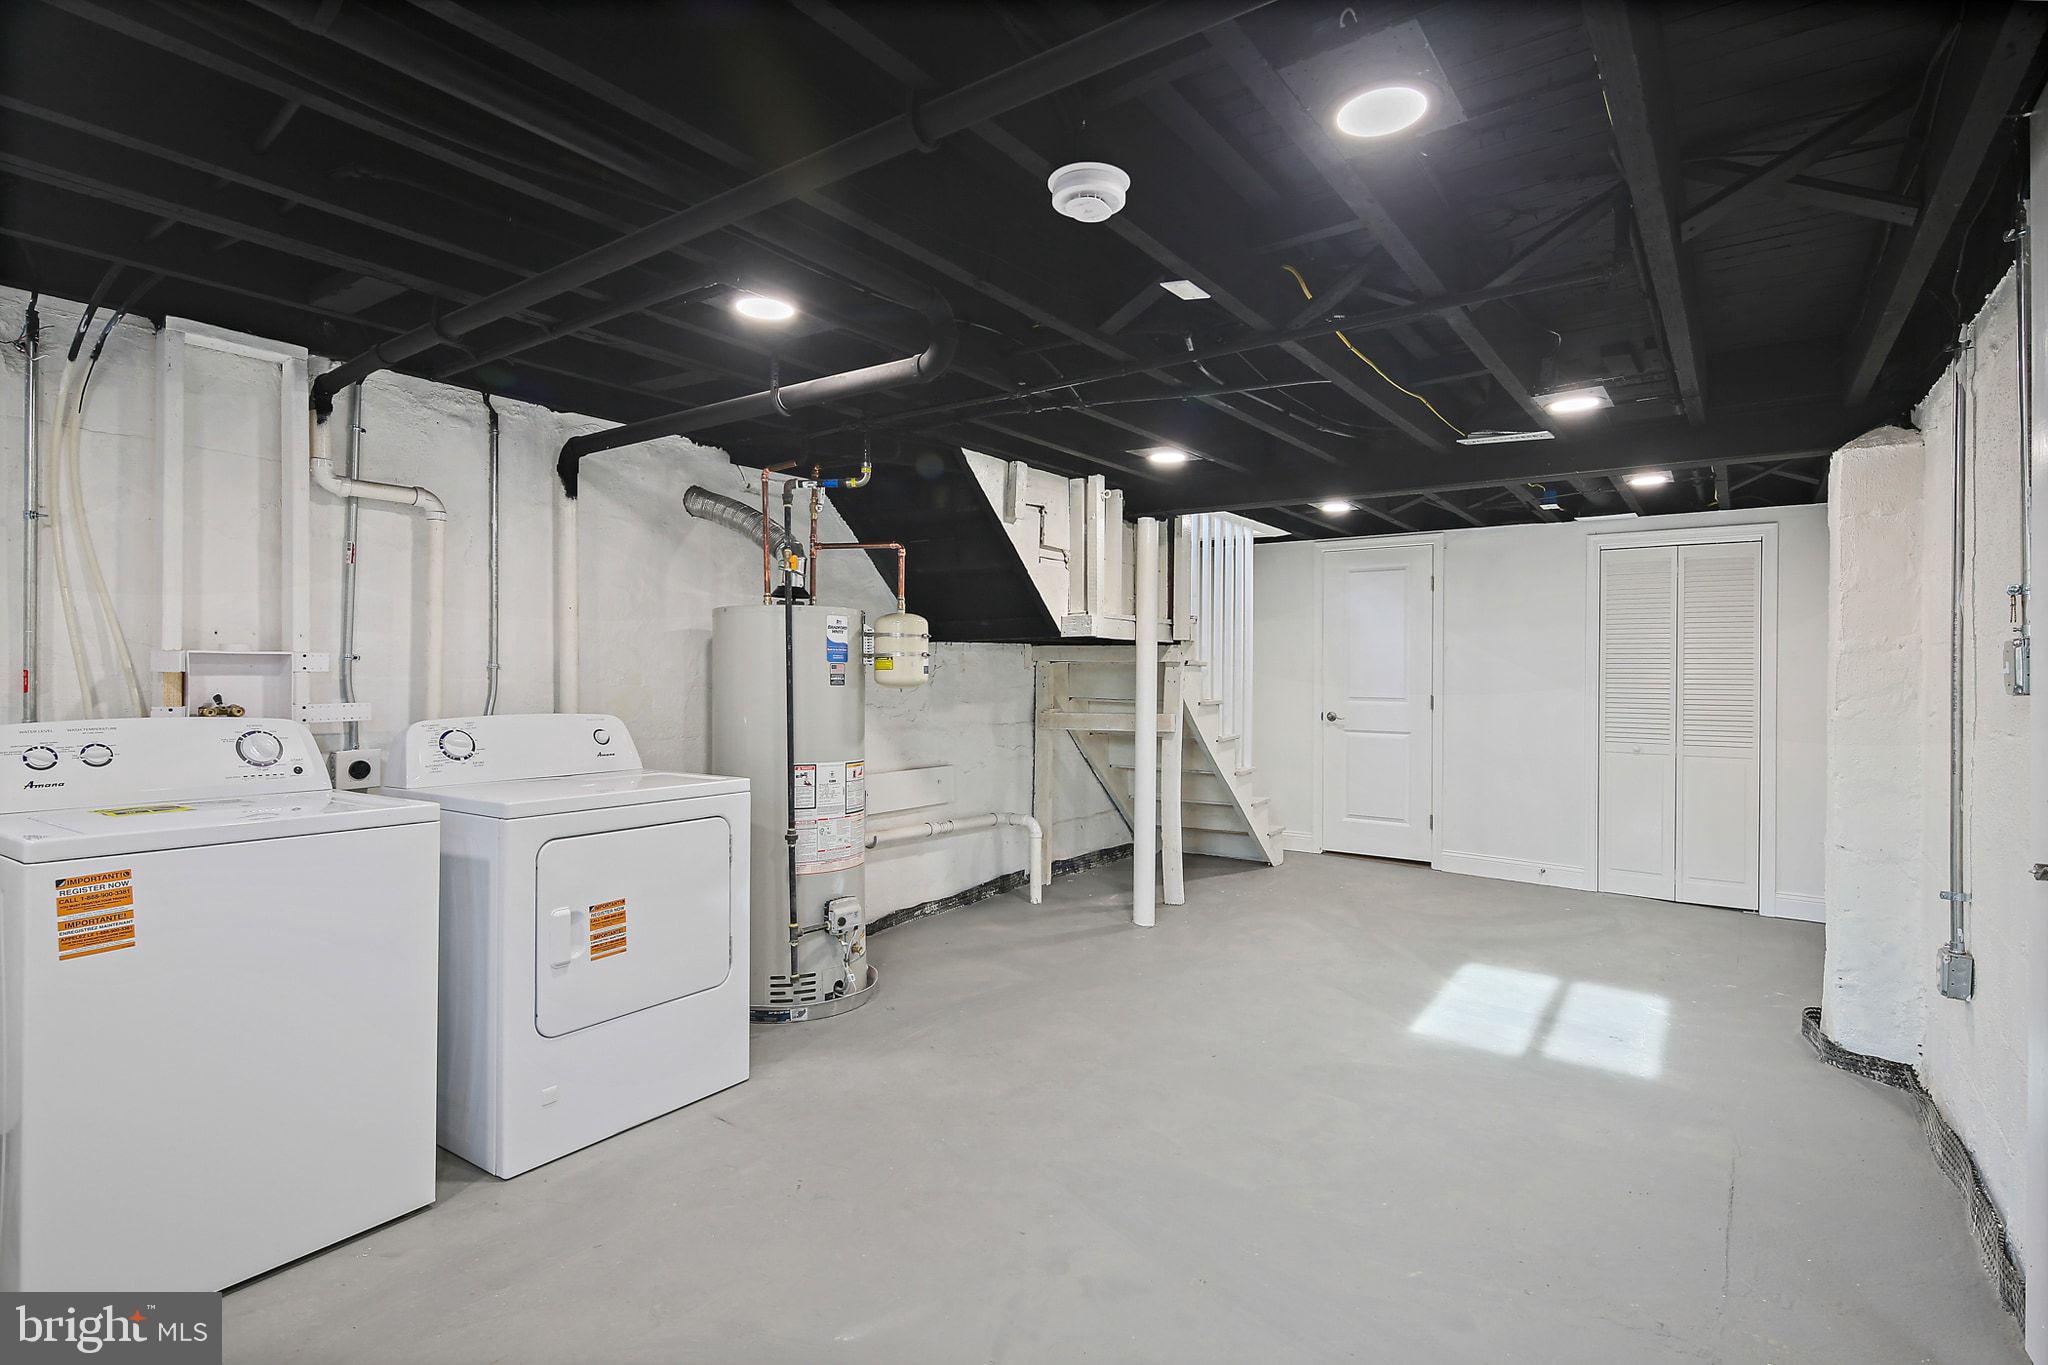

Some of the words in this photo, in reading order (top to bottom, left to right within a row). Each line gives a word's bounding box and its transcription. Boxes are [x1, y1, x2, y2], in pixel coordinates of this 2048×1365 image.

[23, 780, 65, 790] Amana
[66, 871, 122, 886] IMPORTANT!
[59, 884, 106, 896] REGISTER
[108, 880, 130, 889] NOW
[58, 897, 79, 905] CALL
[58, 925, 98, 936] ENREGISTREZ
[99, 920, 133, 928] MAINTENANT
[64, 912, 127, 929] IMPORTANTE!
